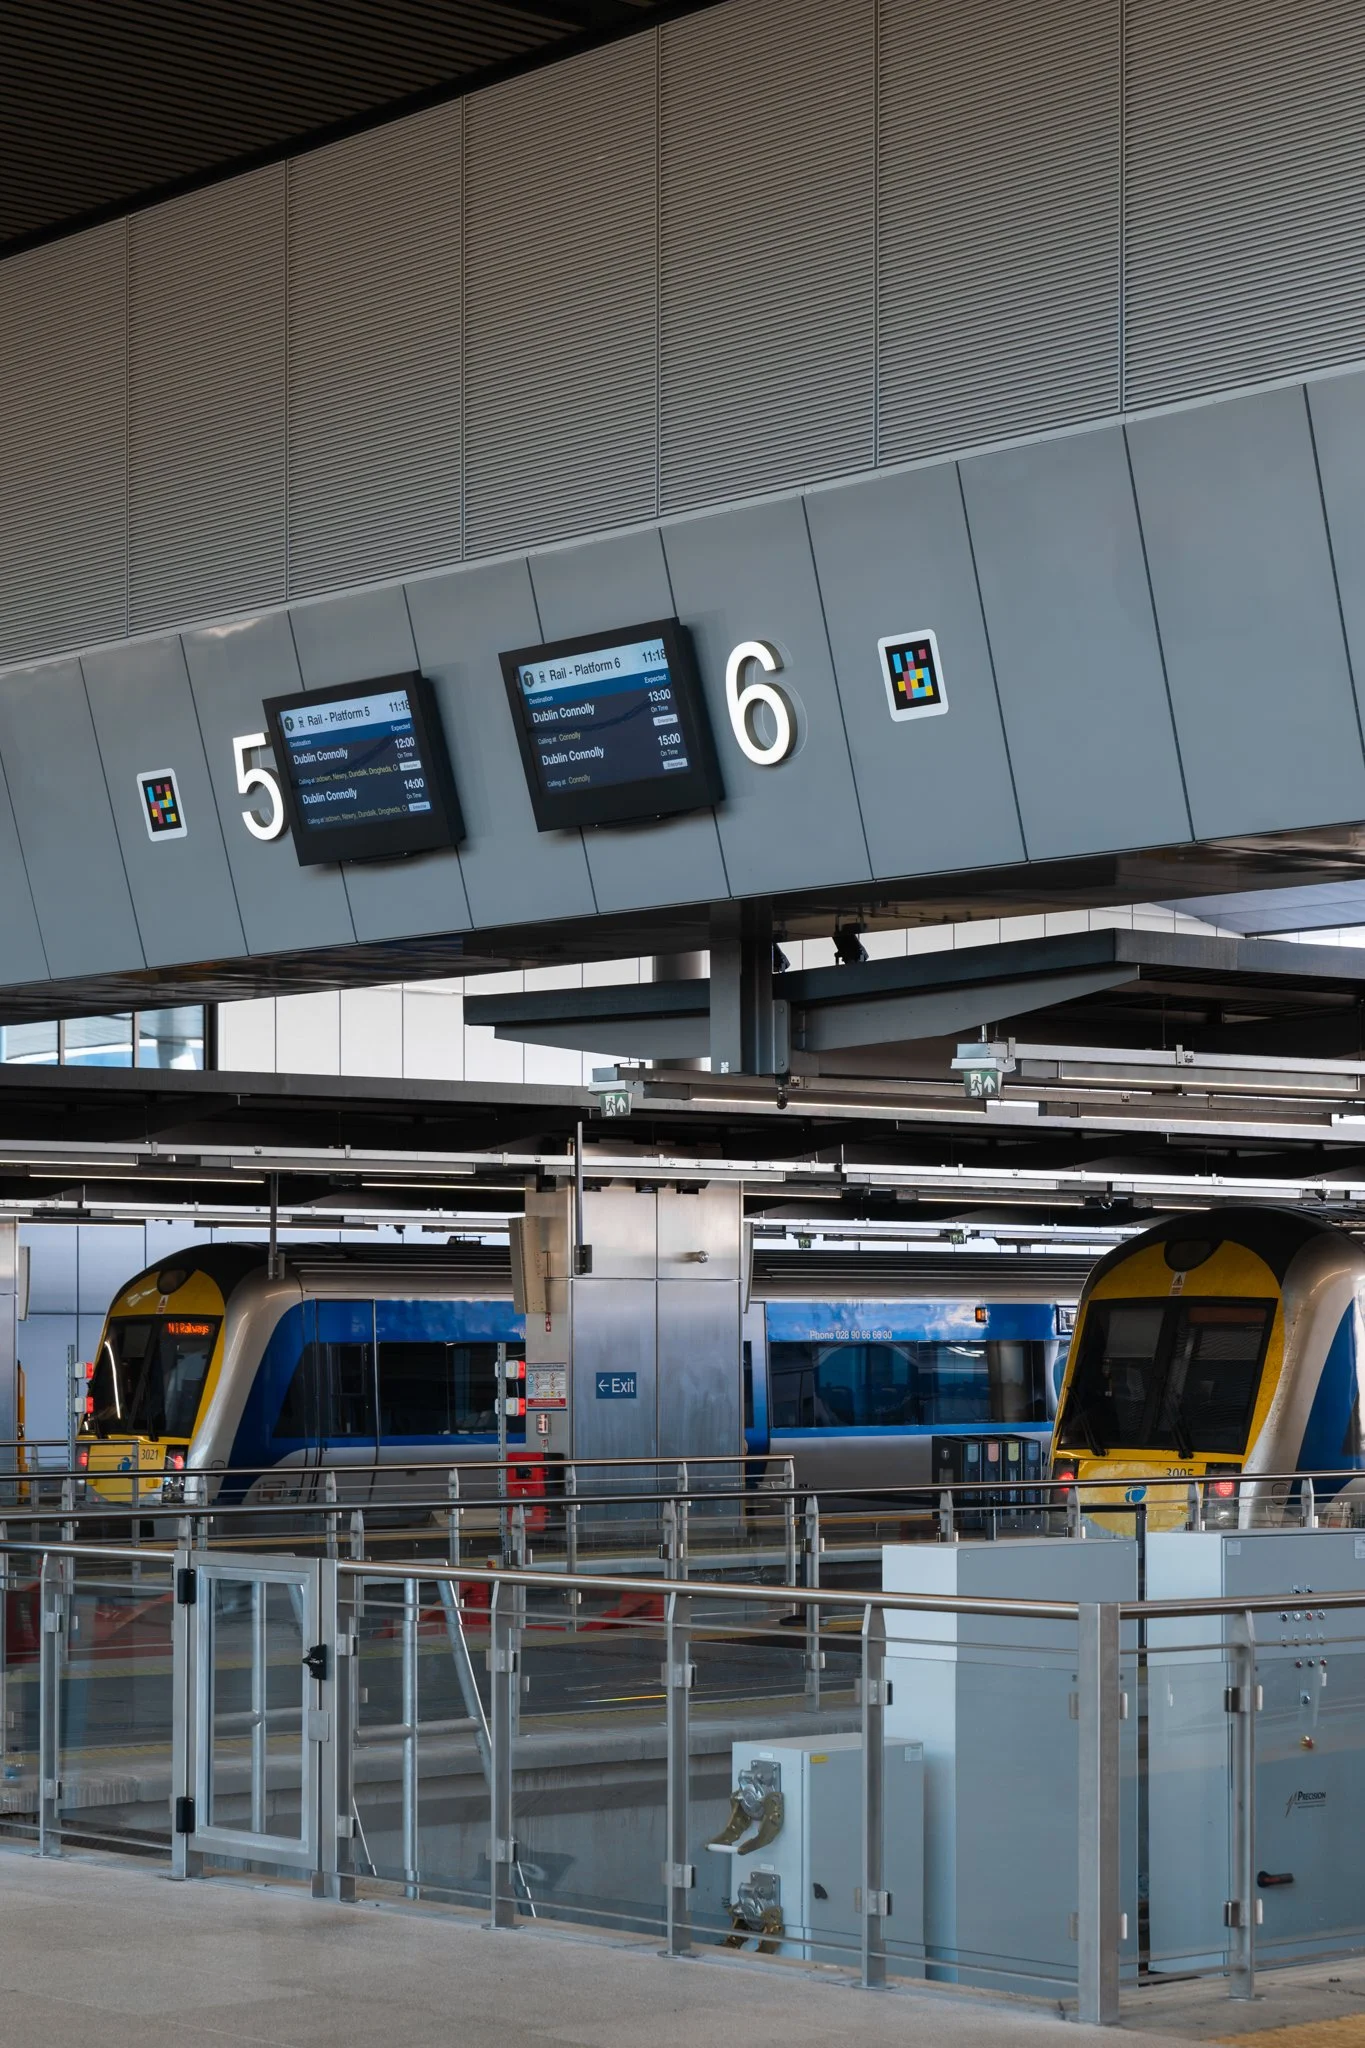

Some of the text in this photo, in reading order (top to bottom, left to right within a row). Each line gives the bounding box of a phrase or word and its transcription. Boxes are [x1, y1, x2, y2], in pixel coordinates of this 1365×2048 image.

[642, 649, 666, 663] 11:18
[550, 668, 566, 681] Rail
[575, 662, 613, 677] Platform
[614, 657, 620, 668] 6
[644, 674, 666, 684] Expected
[529, 695, 553, 704] Destination
[648, 688, 671, 702] 13:00
[389, 700, 410, 713] 11:18
[725, 641, 794, 766] 6
[308, 714, 322, 726] Rail
[330, 709, 363, 723] Platform
[364, 706, 370, 717] 5
[533, 703, 595, 723] Dublin Connolly
[391, 724, 410, 732] Expected
[394, 736, 415, 749] 12:00
[559, 732, 581, 742] Connolly
[658, 733, 681, 746] 15:00
[290, 740, 311, 748] Destination
[294, 748, 348, 765] Dublin Connolly
[542, 747, 604, 766] Dublin Connolly
[404, 778, 424, 790] 14:00
[568, 774, 590, 784] Connolly
[232, 732, 284, 841] 5
[303, 788, 357, 804] Dublin Connolly
[810, 1330, 834, 1340] Phone
[836, 1330, 850, 1340] 028
[850, 1330, 860, 1340] 90
[862, 1330, 870, 1340] 66
[883, 1330, 892, 1340] 30
[611, 1378, 635, 1393] Exit
[141, 1448, 159, 1461] 3021
